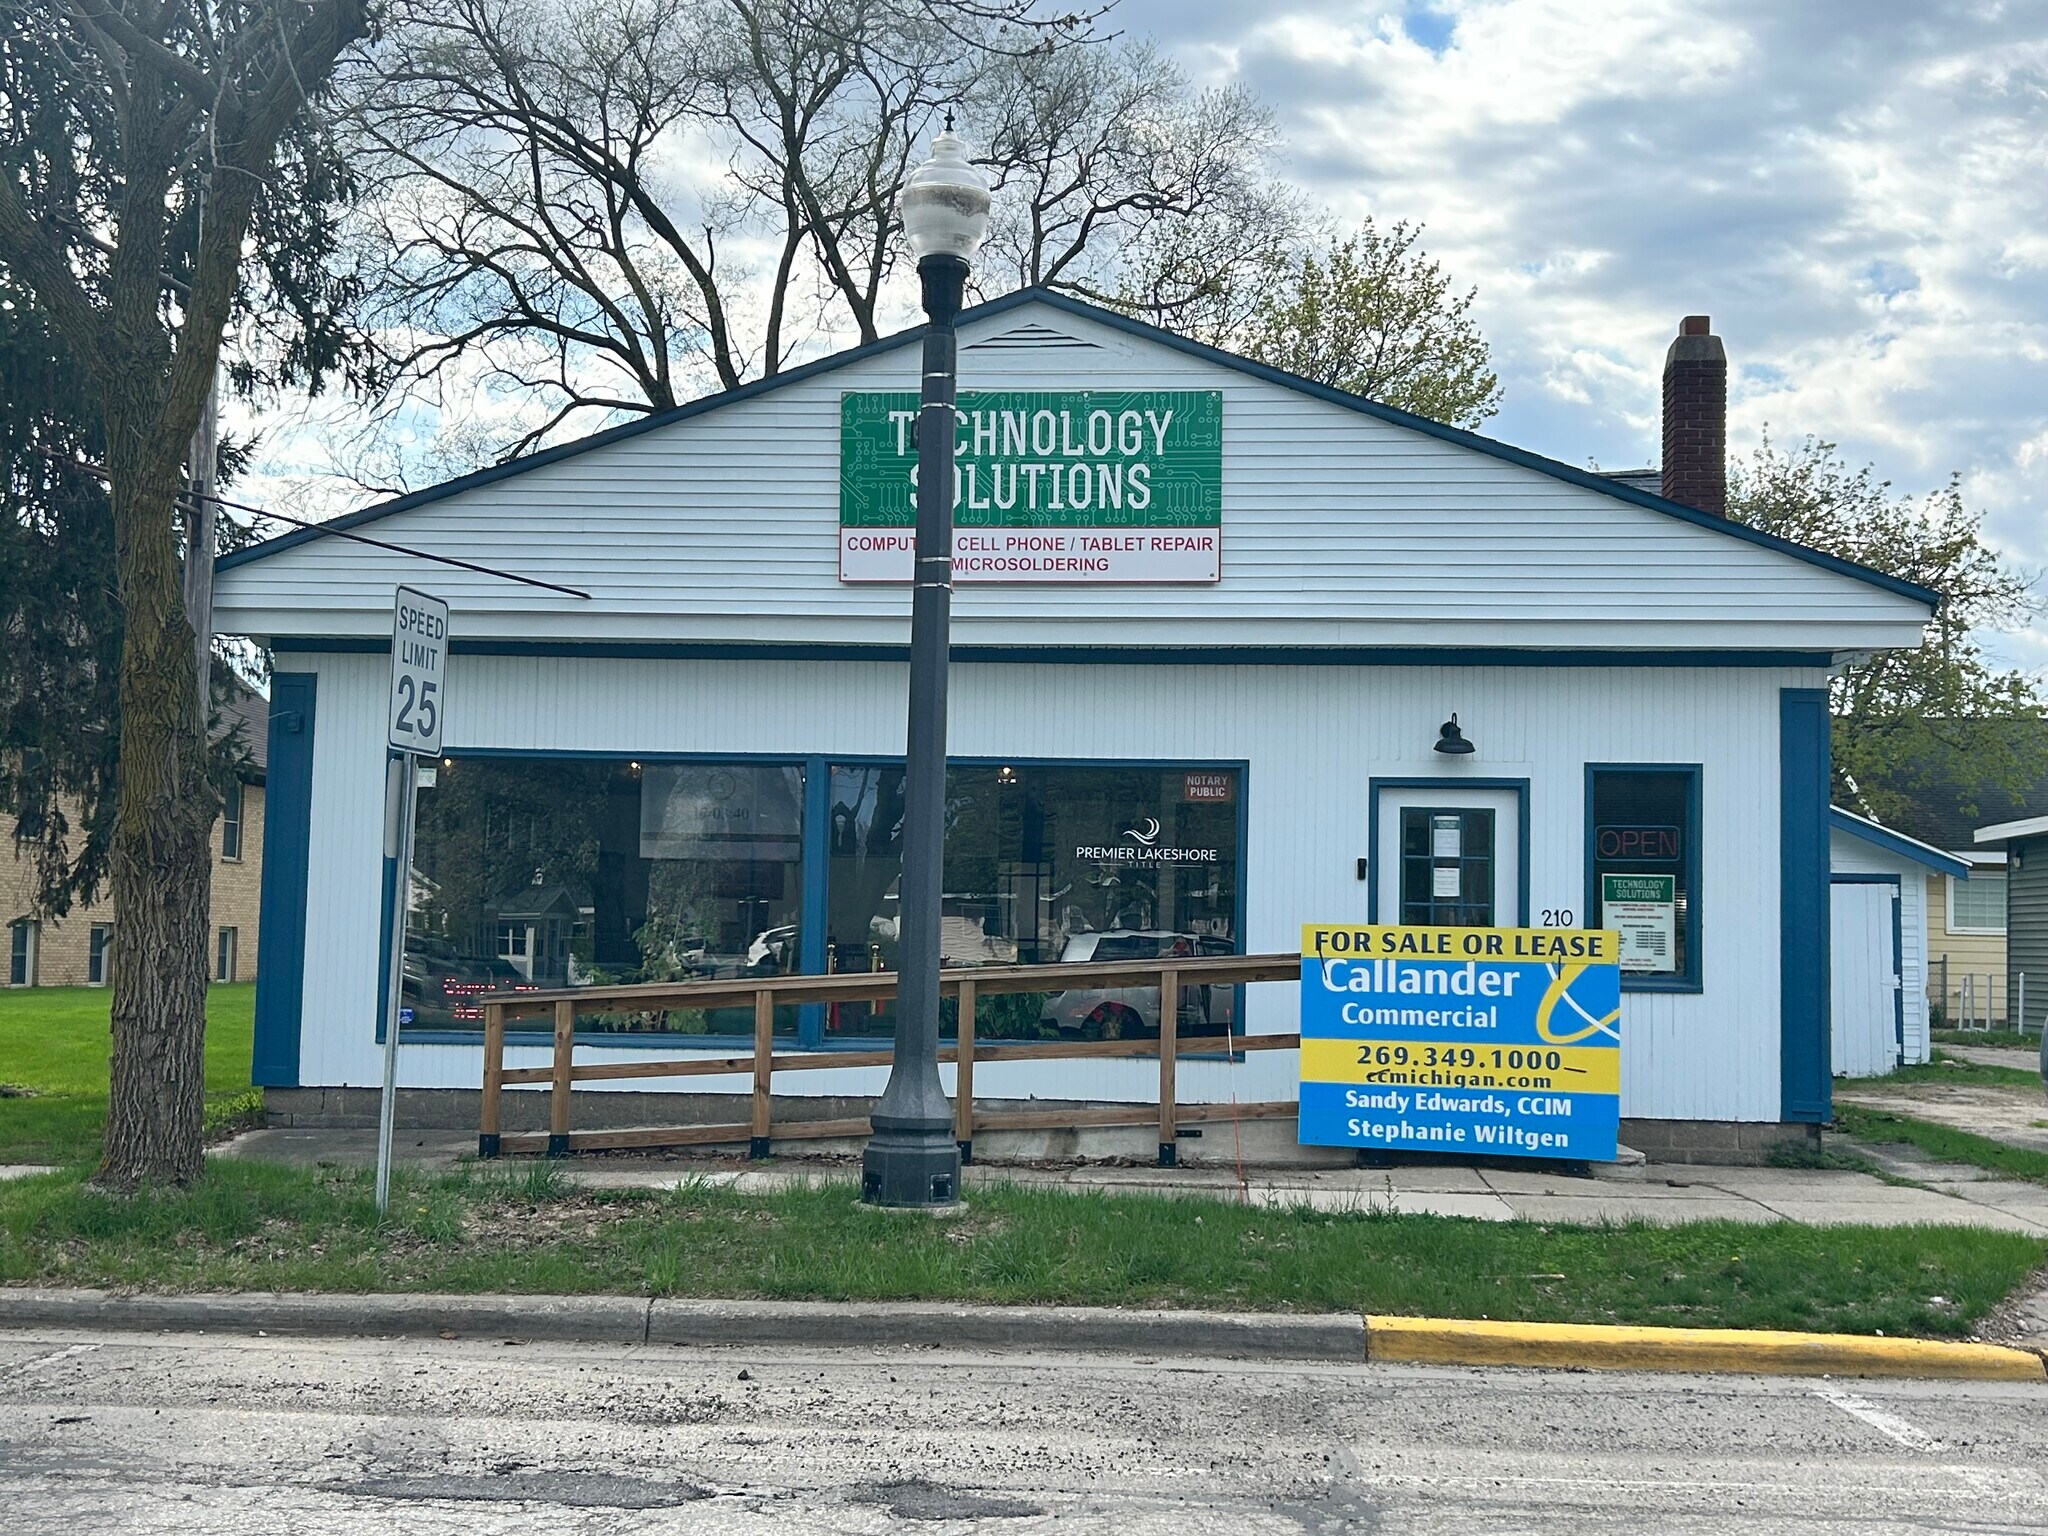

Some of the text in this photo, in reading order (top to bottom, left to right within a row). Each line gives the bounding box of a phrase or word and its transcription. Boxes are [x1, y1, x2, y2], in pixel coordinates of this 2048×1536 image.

[889, 410, 1173, 456] TCHNOLOGY
[957, 536, 1000, 551] CELL
[1006, 536, 1065, 551] PHONE
[1080, 536, 1145, 551] TABLET
[1151, 536, 1213, 551] REPAIR
[951, 556, 1109, 572] MICROSOLDERING
[400, 605, 443, 640] SPEED
[402, 640, 438, 671] LIMIT
[396, 675, 437, 738] 25
[1187, 776, 1228, 785] NOTARY
[1190, 787, 1226, 797] PUBLIC
[1076, 847, 1217, 861] PREMIER LAKESHORE
[1600, 831, 1677, 856] OPEN
[1128, 861, 1161, 869] TITLE
[1612, 879, 1665, 889] TECHNOLOGY
[1616, 889, 1661, 899] SOLUTIONS
[1542, 909, 1573, 927] 210
[1316, 931, 1371, 952] FOR
[1382, 932, 1452, 954] SALE
[1463, 934, 1504, 955] OR
[1515, 935, 1603, 957] LEASE
[1323, 959, 1520, 997] Callander
[1342, 1003, 1497, 1028] Commercial
[1357, 1046, 1561, 1070] 269.349.1000
[1367, 1069, 1551, 1088] ccmichigan.com
[1345, 1090, 1571, 1117] Sandy Edwards, CCIM
[1348, 1119, 1568, 1148] Stephanie Wiltgen
